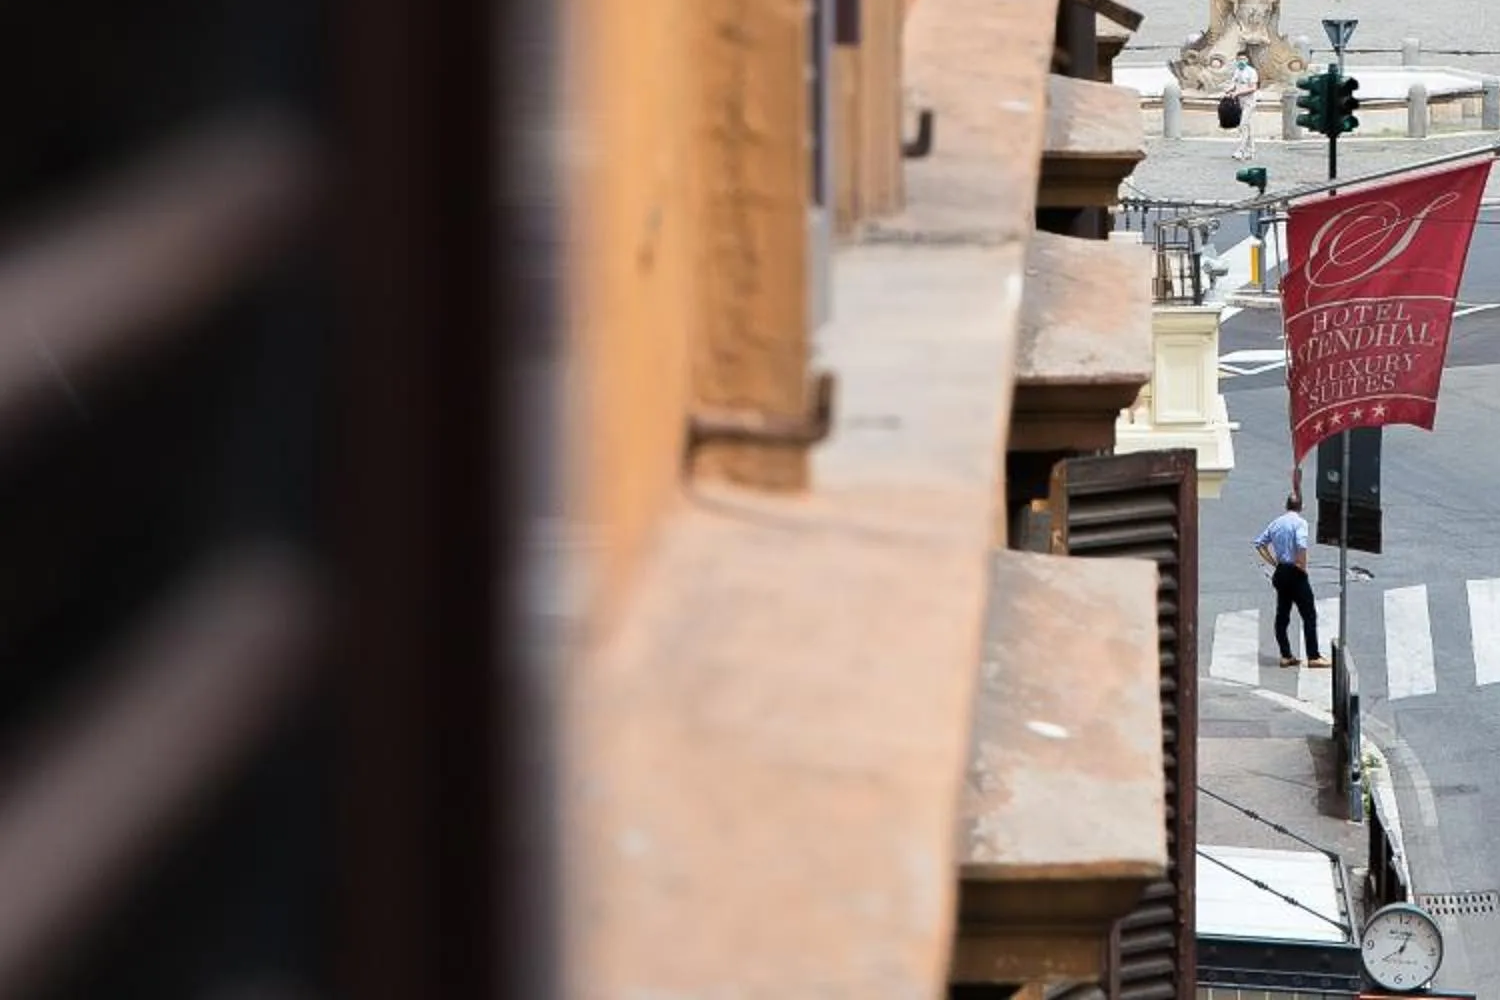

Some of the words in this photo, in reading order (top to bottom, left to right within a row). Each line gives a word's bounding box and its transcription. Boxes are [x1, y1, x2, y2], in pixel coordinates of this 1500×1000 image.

[1312, 302, 1411, 335] HOTEL
[1315, 351, 1422, 387] LUXURY
[1308, 372, 1397, 410] SUITES
[1366, 939, 1375, 950] 9
[1394, 973, 1404, 984] 6
